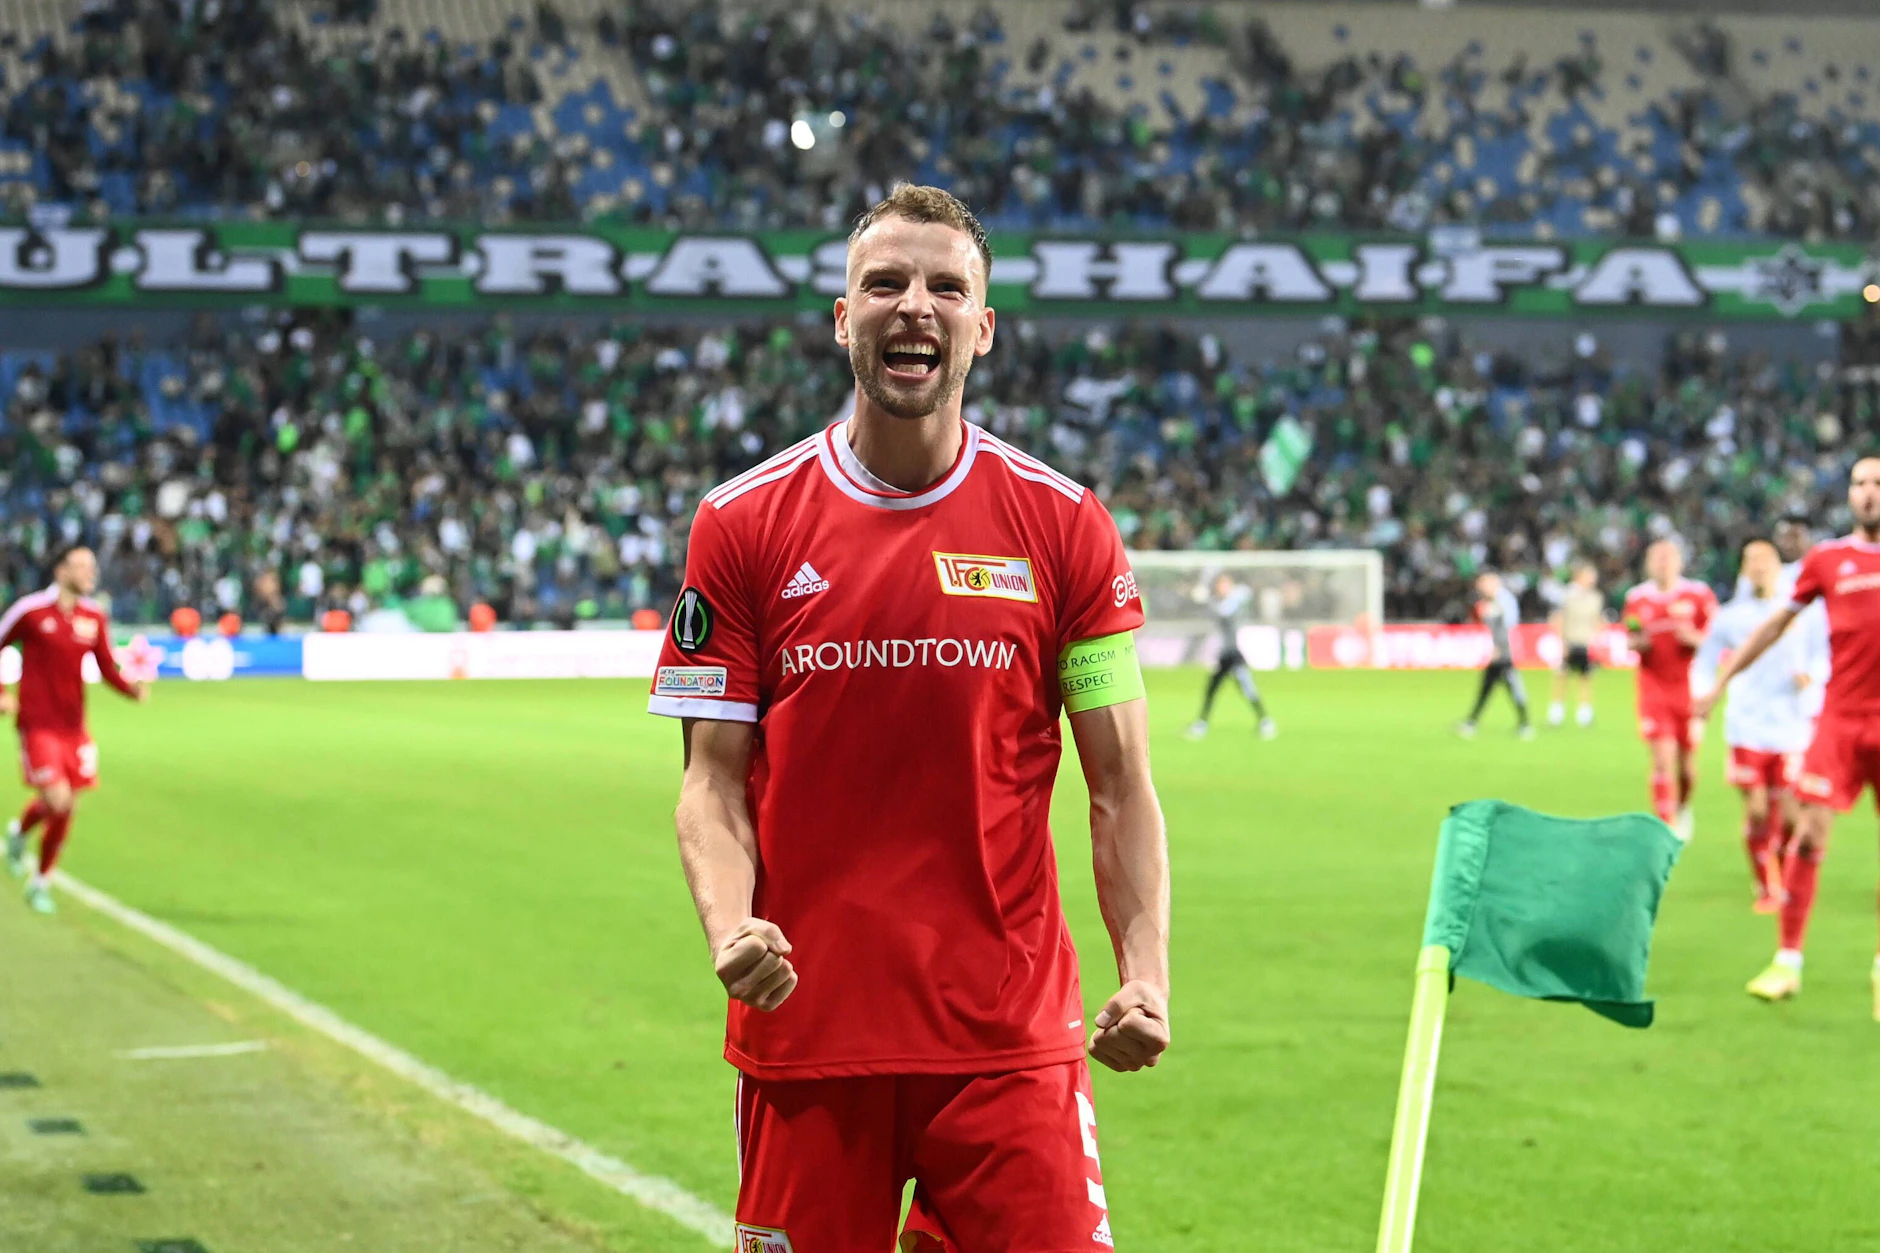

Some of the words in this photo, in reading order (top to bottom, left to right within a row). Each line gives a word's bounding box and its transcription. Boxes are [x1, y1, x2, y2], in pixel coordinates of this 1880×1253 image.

[1033, 241, 1706, 305] HAIFA
[781, 579, 830, 600] adidas
[991, 572, 1030, 593] UNION
[781, 638, 1018, 676] AROUNDTOWN
[1071, 650, 1116, 668] RACISM
[658, 676, 724, 687] FOUNDATION
[1062, 672, 1114, 694] RESPECT
